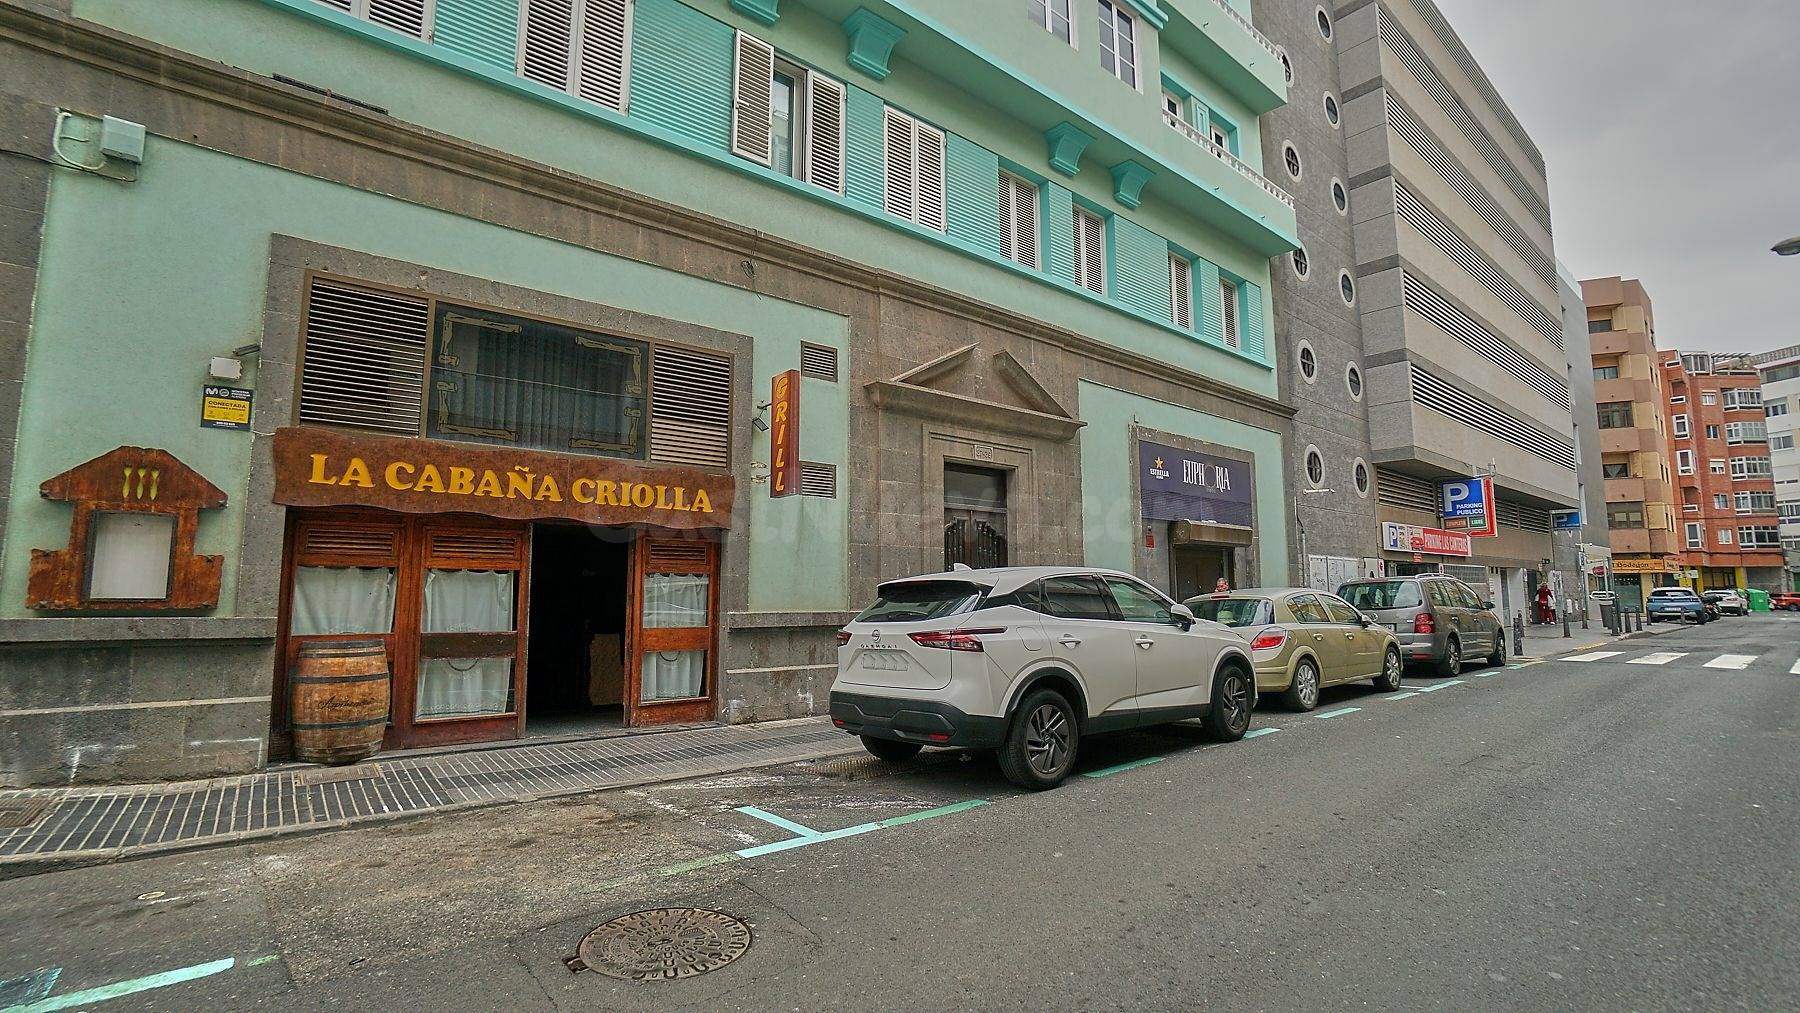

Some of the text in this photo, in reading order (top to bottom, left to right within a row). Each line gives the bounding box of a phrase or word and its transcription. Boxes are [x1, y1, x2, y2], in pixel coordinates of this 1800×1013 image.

[775, 376, 788, 492] GRILL
[309, 453, 714, 513] LA CABAÑA CRIOLLA
[1150, 468, 1170, 478] ESTRELLA
[1443, 483, 1470, 512] P
[1456, 502, 1483, 510] PARKING
